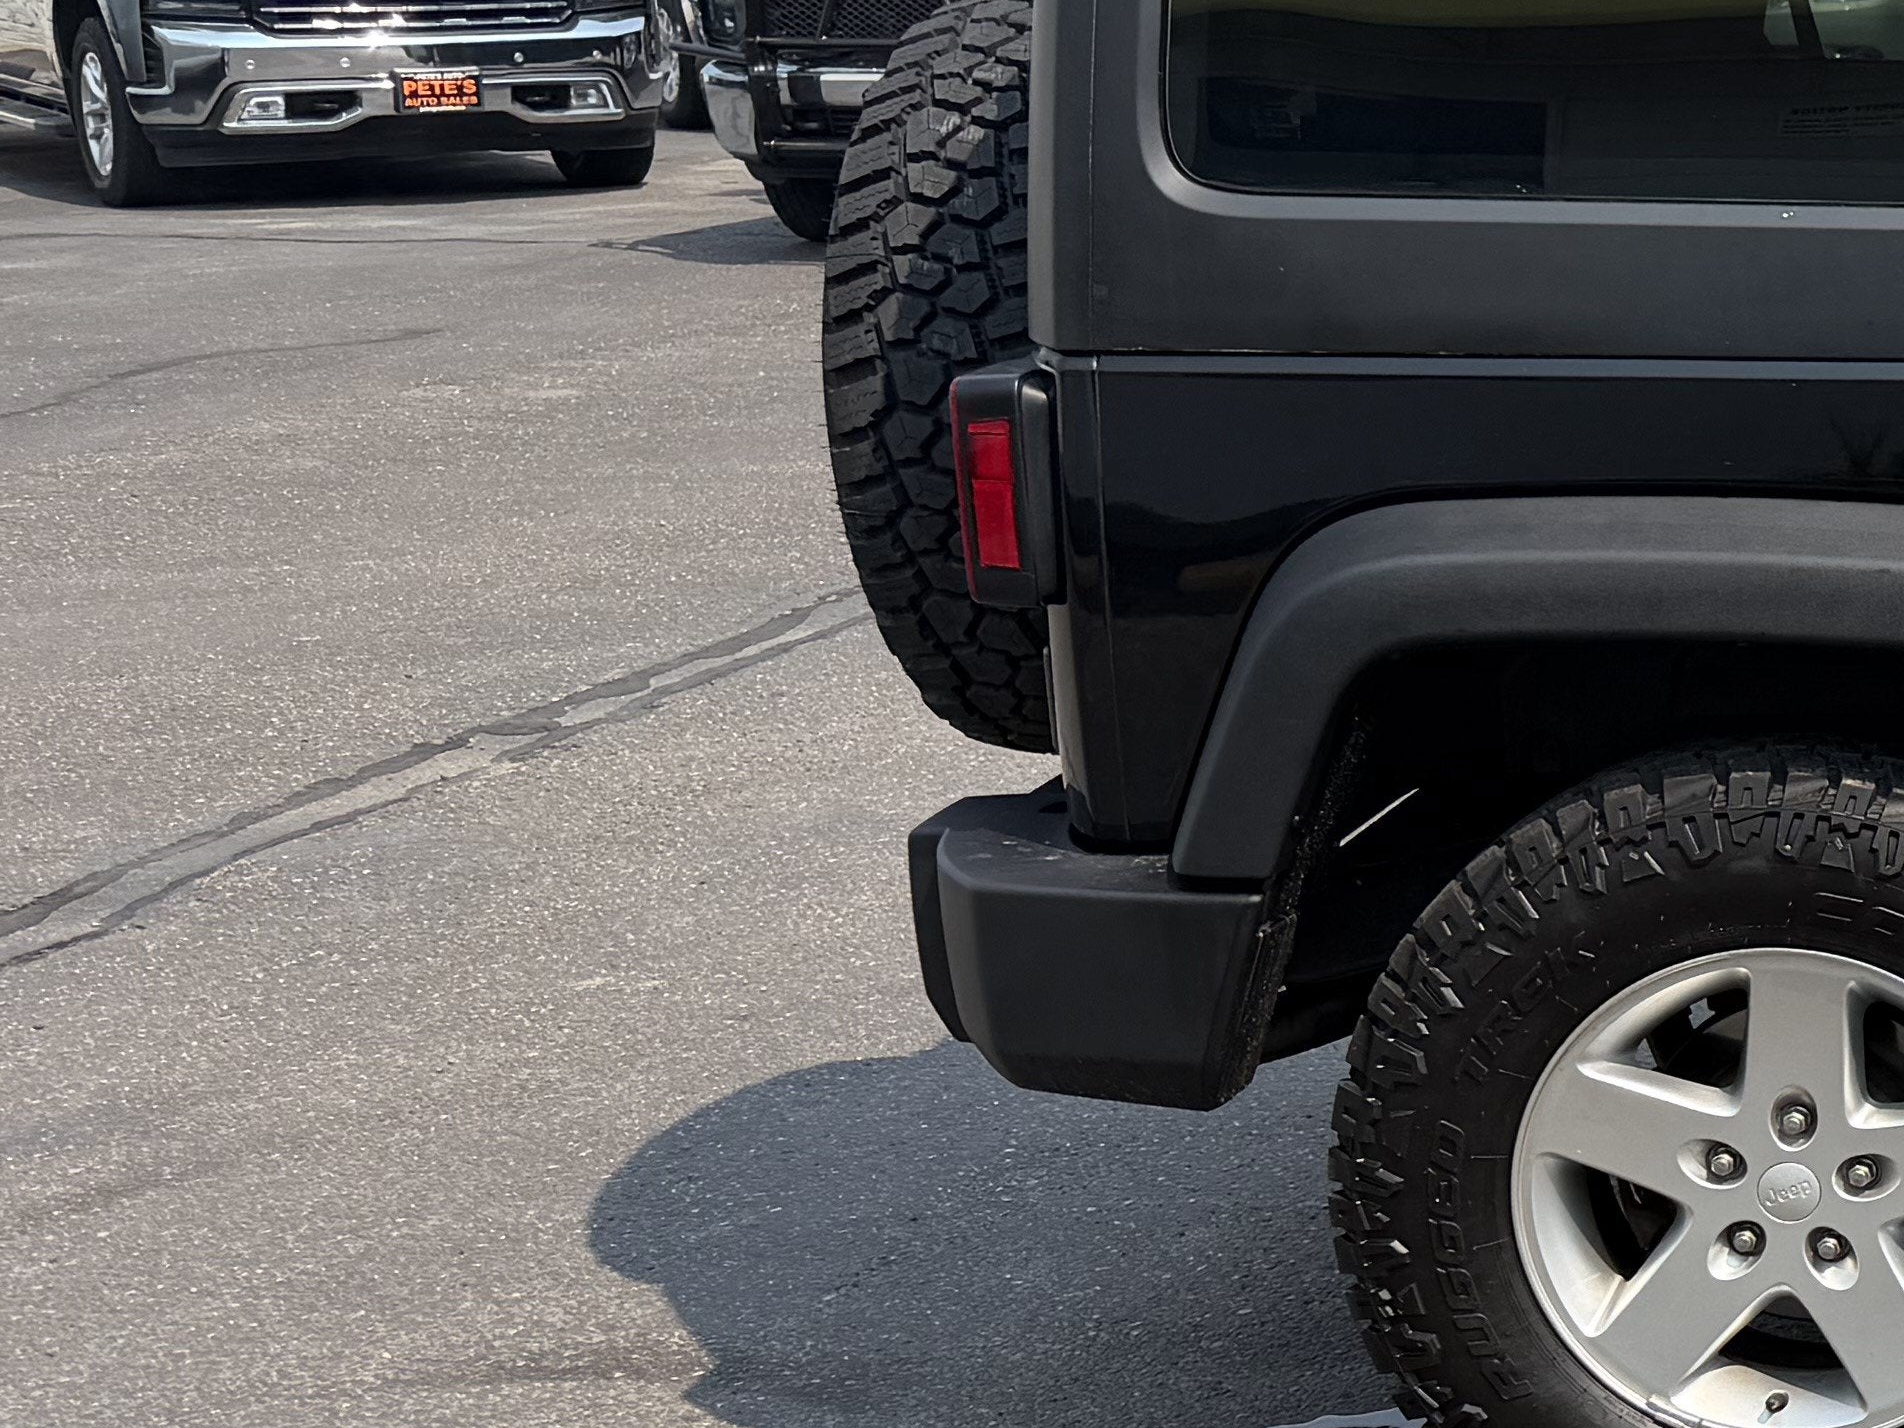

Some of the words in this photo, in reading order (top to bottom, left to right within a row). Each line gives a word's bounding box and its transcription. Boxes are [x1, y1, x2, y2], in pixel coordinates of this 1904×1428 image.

[402, 78, 477, 96] PETE'S
[405, 96, 438, 107] AUTO
[440, 95, 479, 106] SALES
[1764, 1179, 1812, 1207] Jeep
[1425, 1118, 1536, 1403] RUGGED
